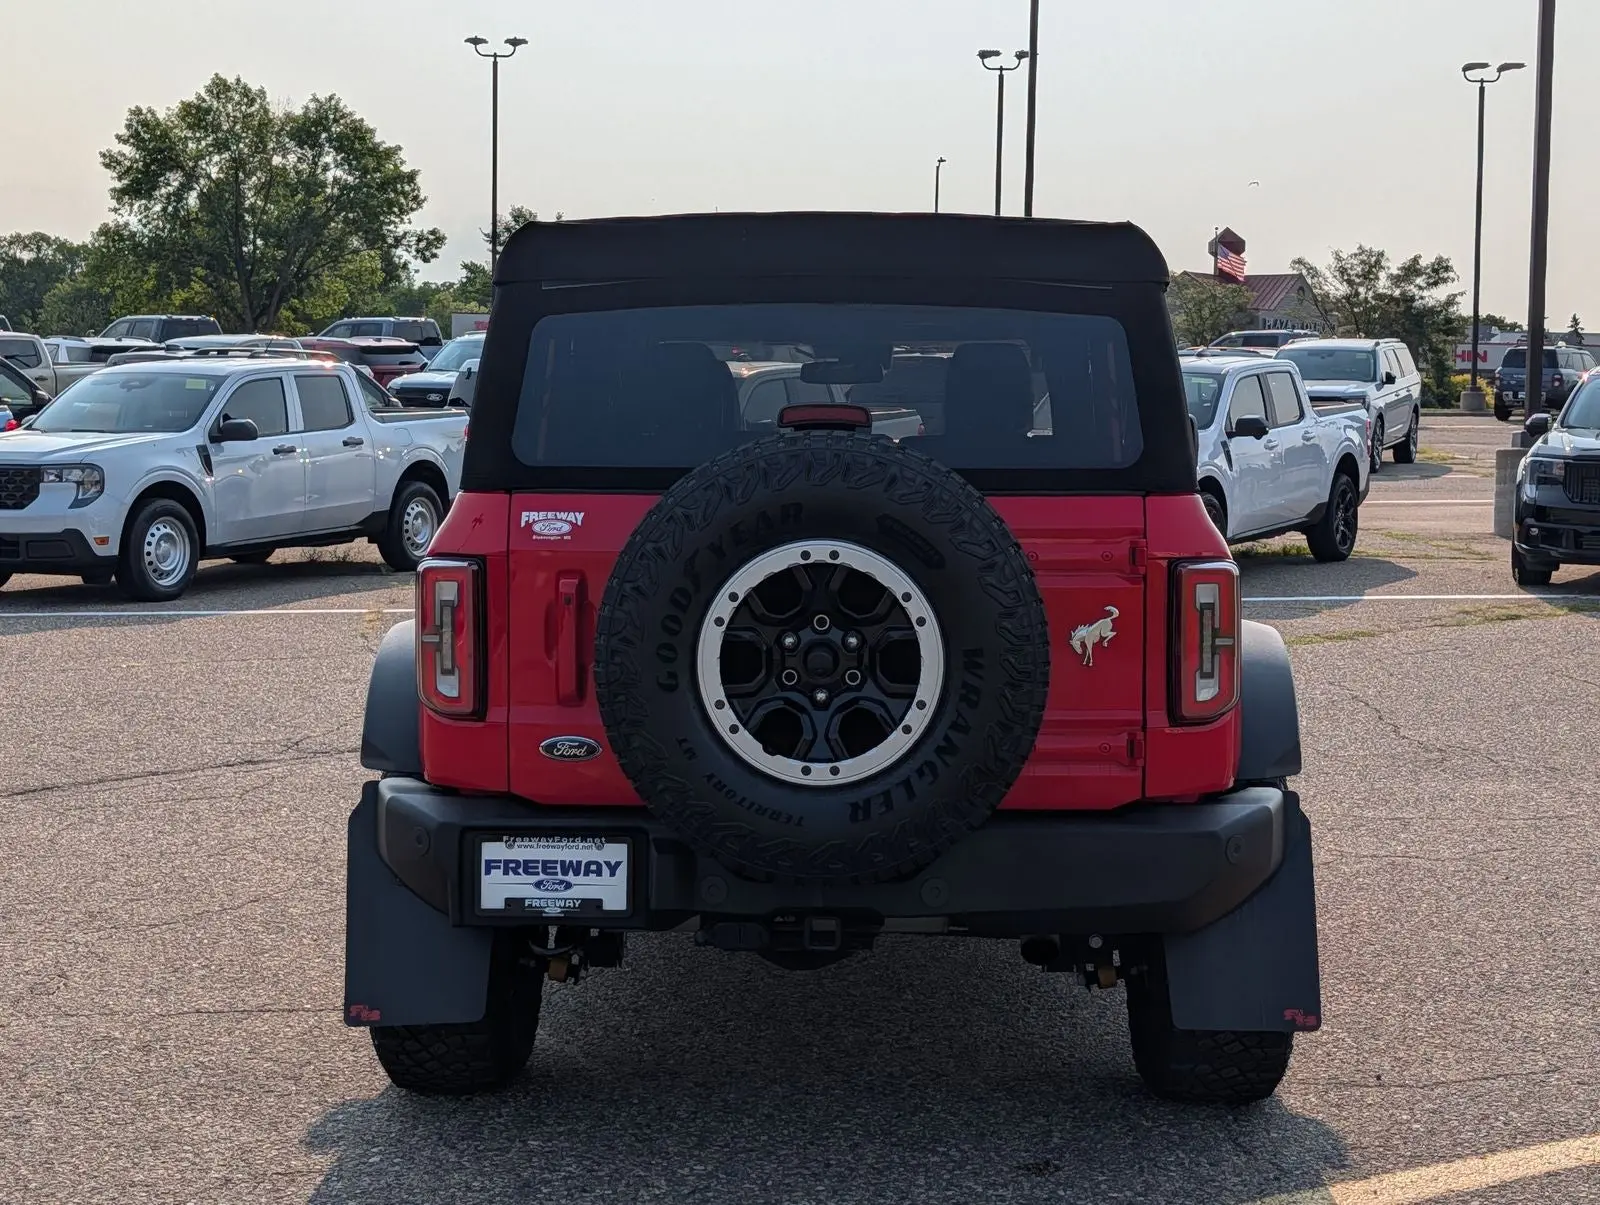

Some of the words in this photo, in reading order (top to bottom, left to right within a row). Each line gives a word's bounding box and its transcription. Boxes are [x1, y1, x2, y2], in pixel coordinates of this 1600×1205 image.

[520, 511, 585, 528] FREEWAY
[540, 522, 563, 532] Ford
[656, 502, 803, 692] GOODYEAR
[849, 646, 985, 823] WRANGLER
[553, 741, 588, 756] Ford
[675, 736, 699, 761] MT
[703, 772, 804, 827] TERRITORY
[517, 843, 594, 851] www.freewayford.net
[484, 858, 624, 877] FREEWAY
[540, 879, 567, 891] Ford
[524, 899, 582, 908] FREEWAY
